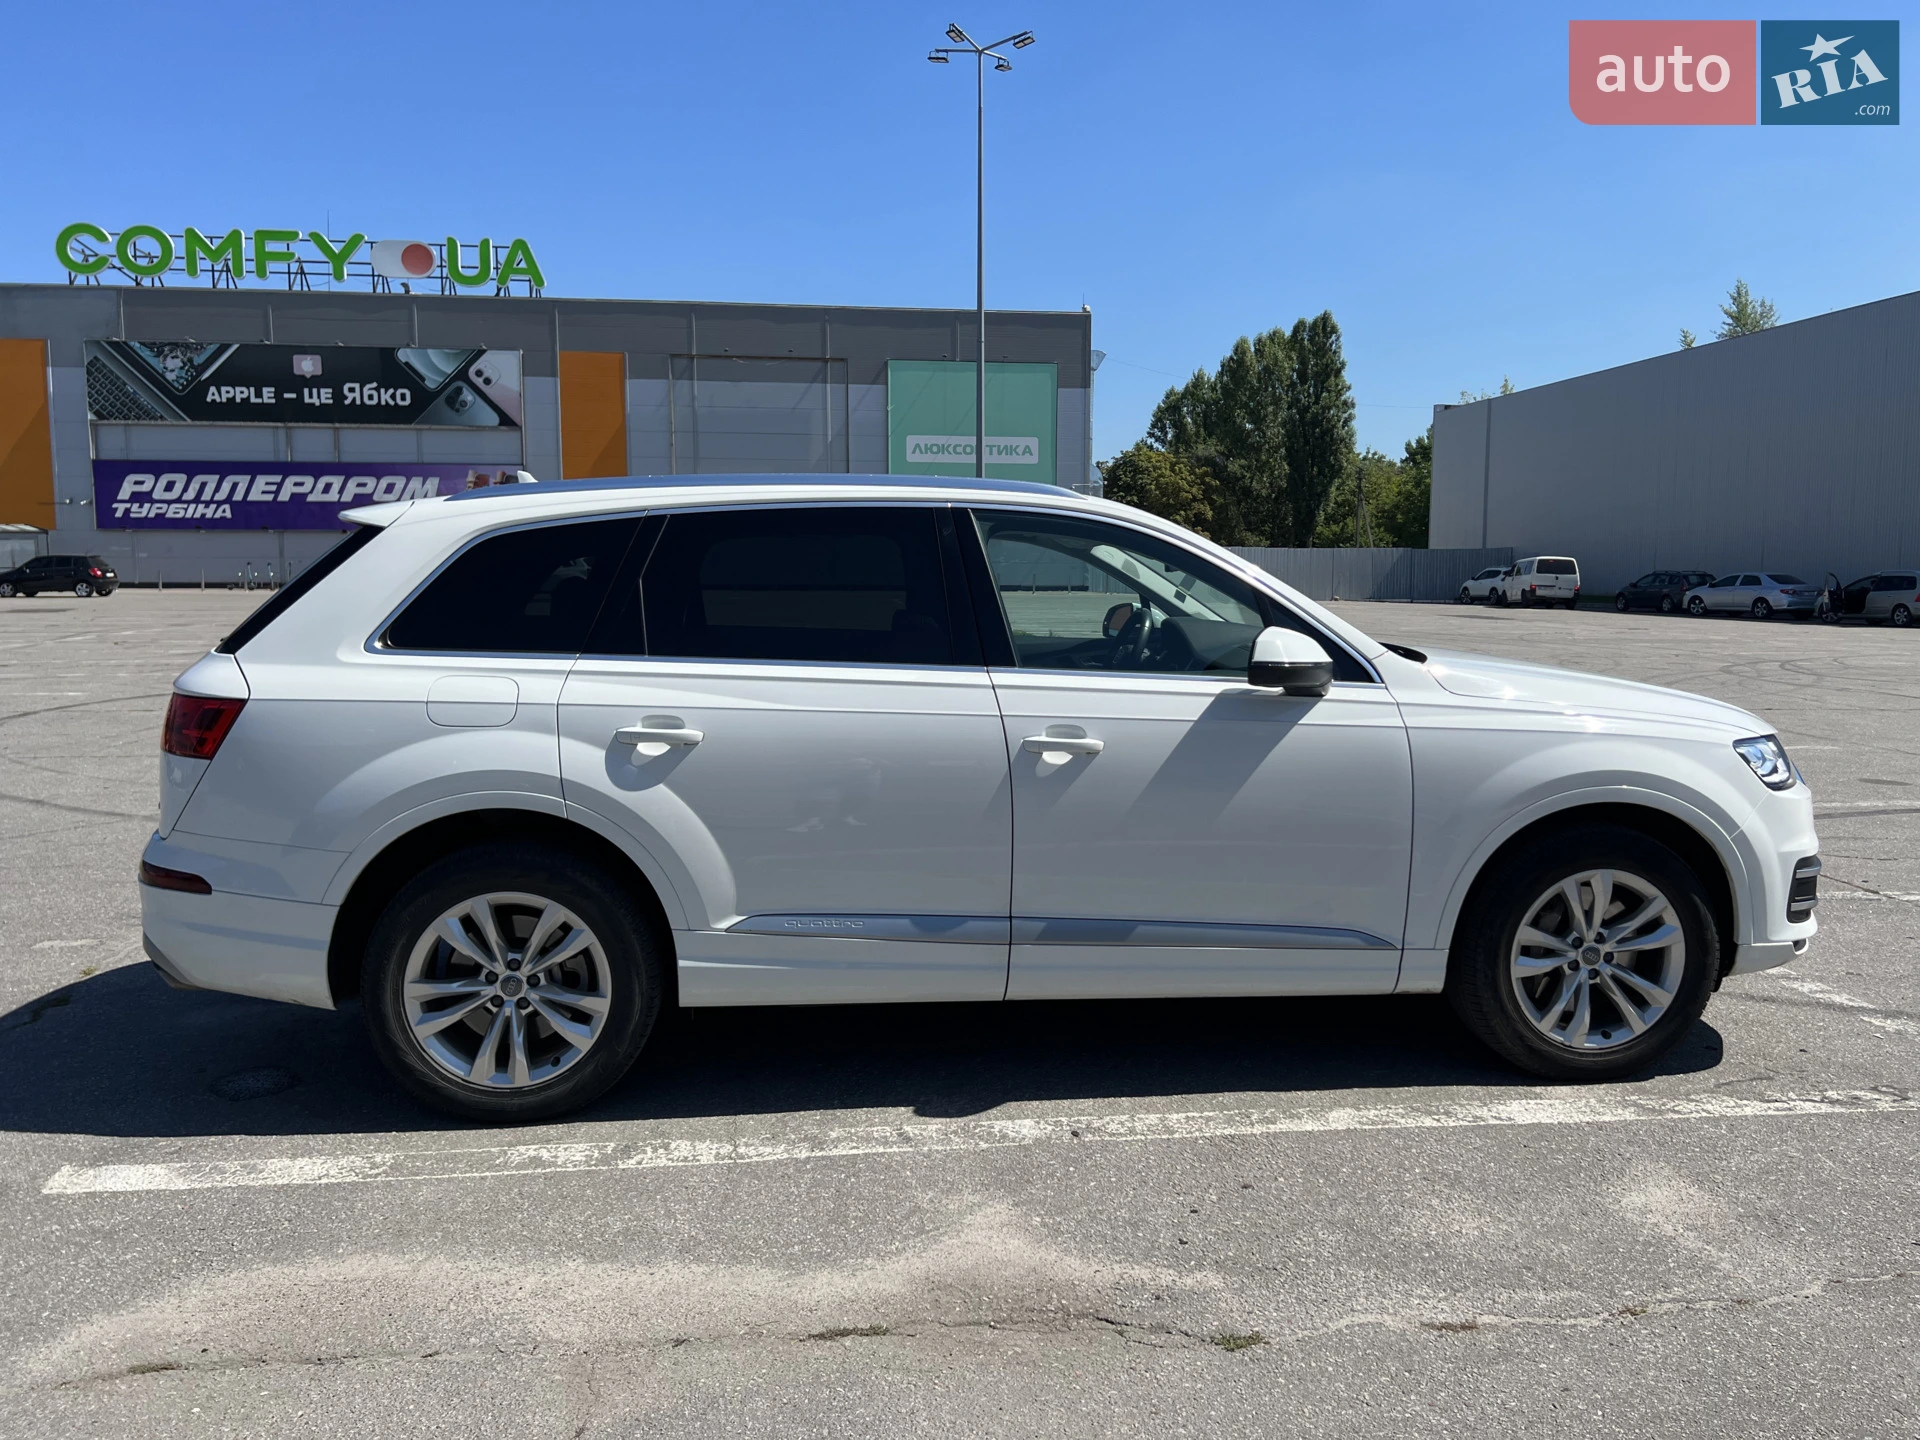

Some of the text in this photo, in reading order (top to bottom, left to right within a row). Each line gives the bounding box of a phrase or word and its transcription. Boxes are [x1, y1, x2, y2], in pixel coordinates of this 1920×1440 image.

[55, 222, 546, 289] COMFY UA
[206, 386, 276, 404] APPLE
[303, 387, 334, 406] ЦЕ
[343, 382, 412, 407] Ябко
[911, 443, 1034, 456] ЛЮКСОТИКА
[116, 472, 441, 503] РОЛЛЕРДРОМ
[111, 502, 233, 520] ТУРБІНА
[784, 919, 864, 929] quattro
